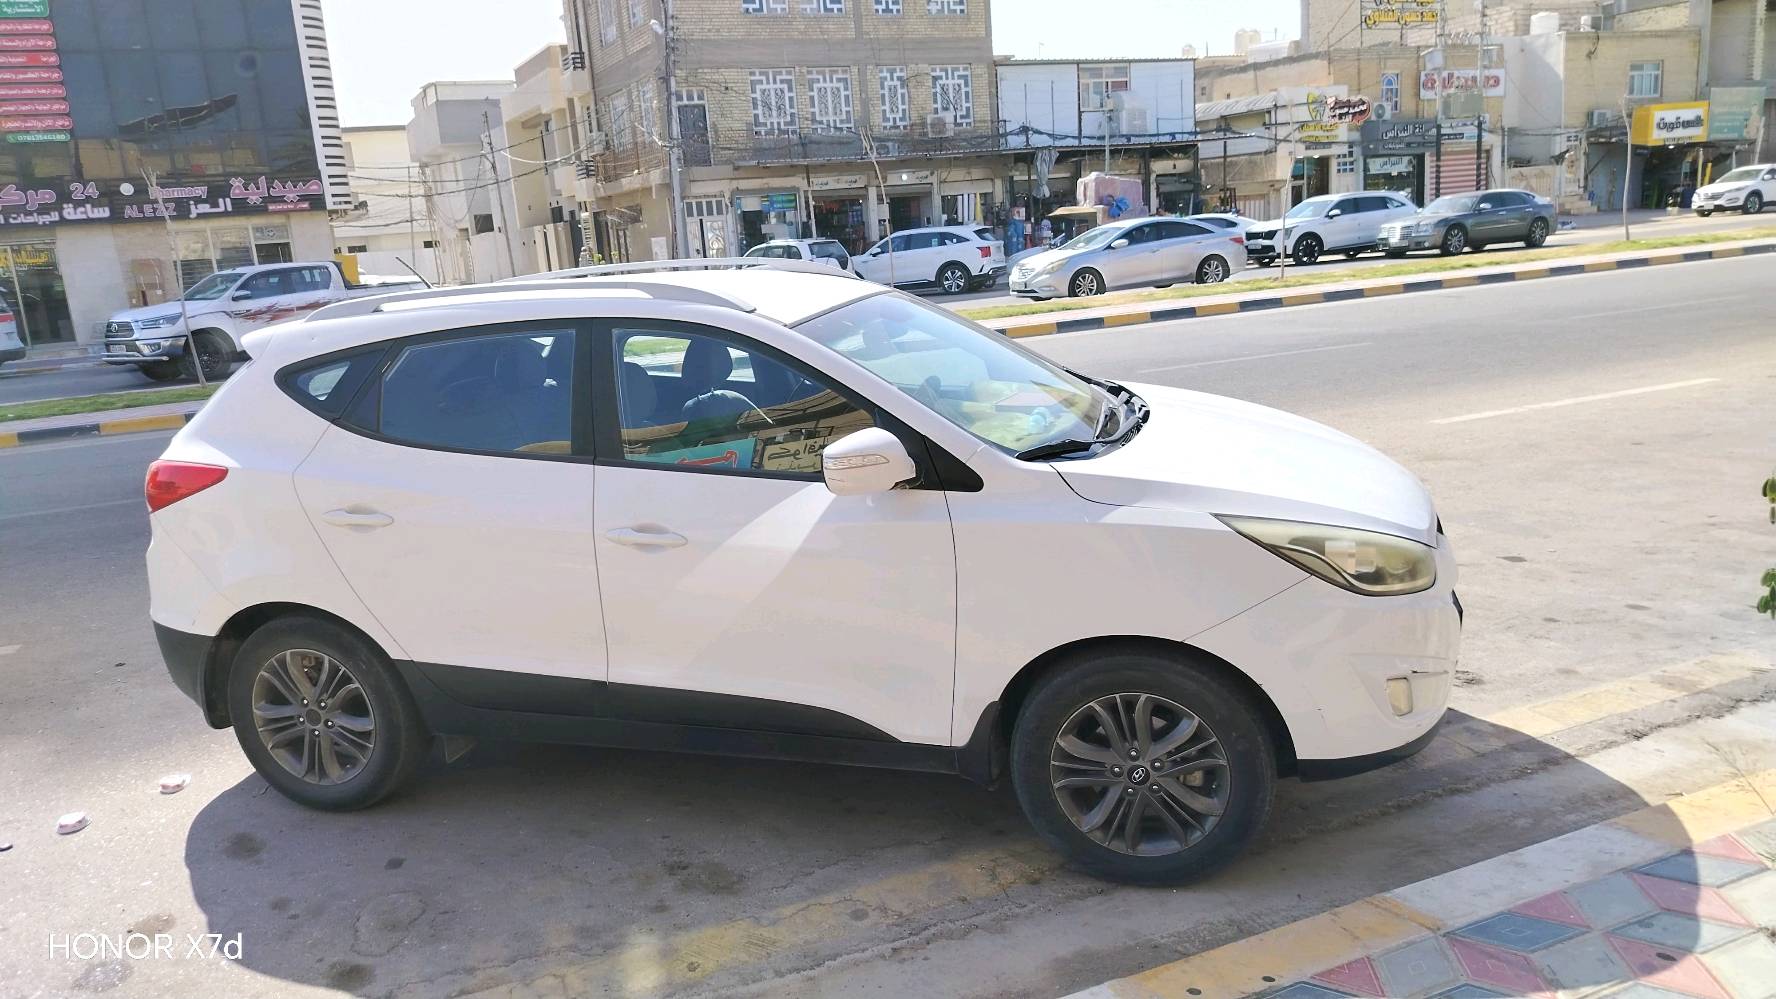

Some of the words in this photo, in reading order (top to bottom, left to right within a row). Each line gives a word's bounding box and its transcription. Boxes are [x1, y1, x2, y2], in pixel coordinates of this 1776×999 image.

[0, 184, 57, 210] مرك
[69, 181, 99, 200] 24
[229, 176, 323, 205] صيدلية
[62, 203, 110, 220] ساعة
[125, 203, 176, 218] ALEZZ
[189, 198, 233, 218] العز
[9, 211, 60, 225] للجراحات
